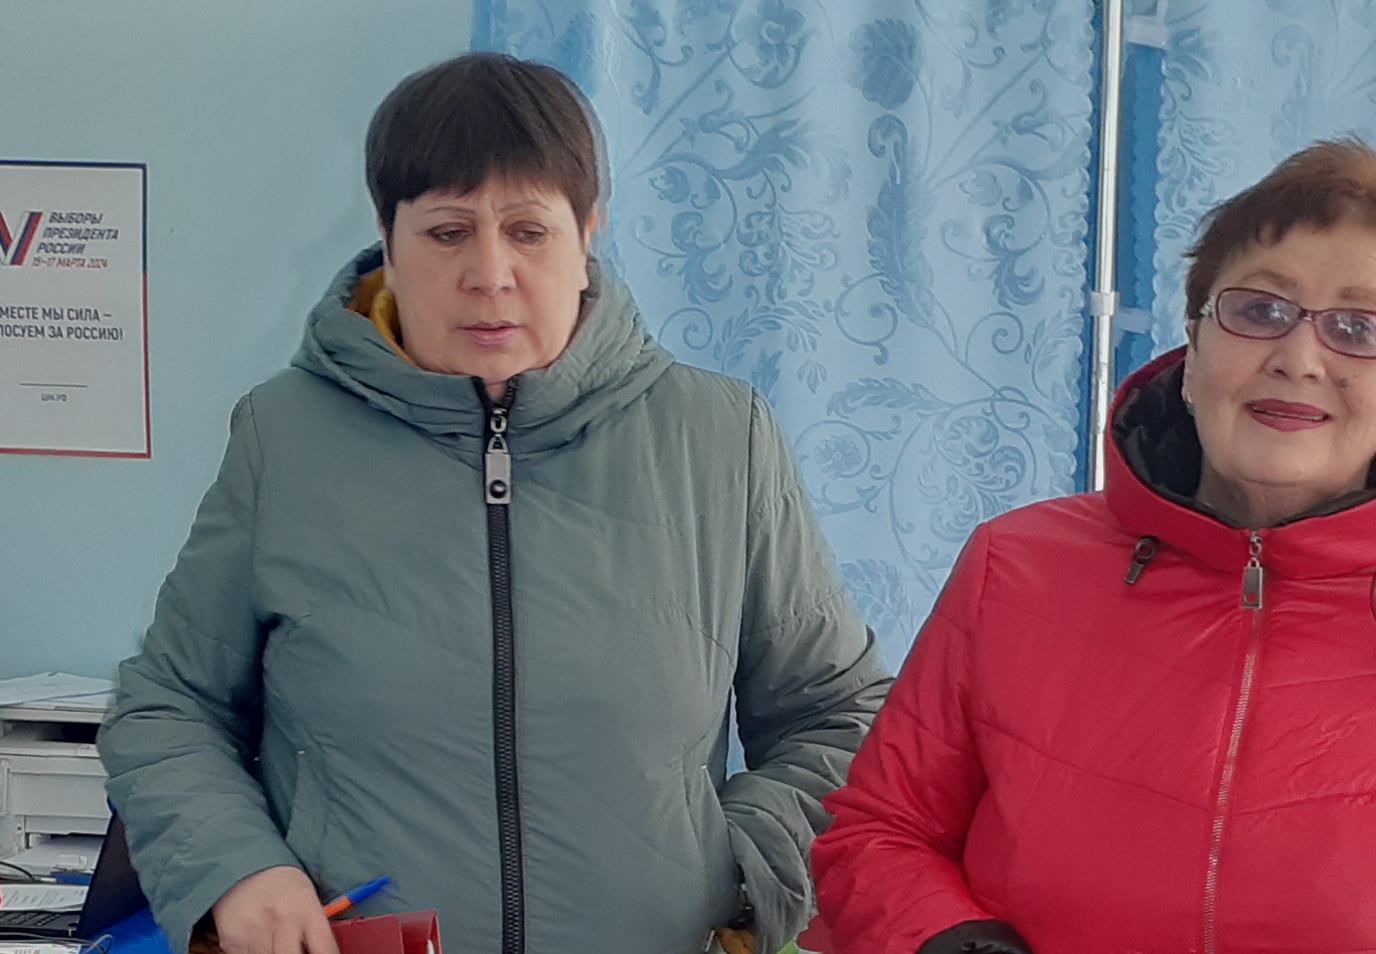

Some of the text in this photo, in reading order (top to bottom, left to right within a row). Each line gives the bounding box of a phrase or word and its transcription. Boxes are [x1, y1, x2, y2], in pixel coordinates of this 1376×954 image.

[49, 211, 104, 225] ВЫБОРЫ
[42, 227, 120, 241] ПРЕЗИДЕНТА
[36, 242, 86, 255] РОССИИ
[42, 307, 64, 320] МЫ
[67, 308, 101, 322] СИЛА
[48, 325, 64, 339] ЗА
[66, 326, 124, 341] РОССИЮ!
